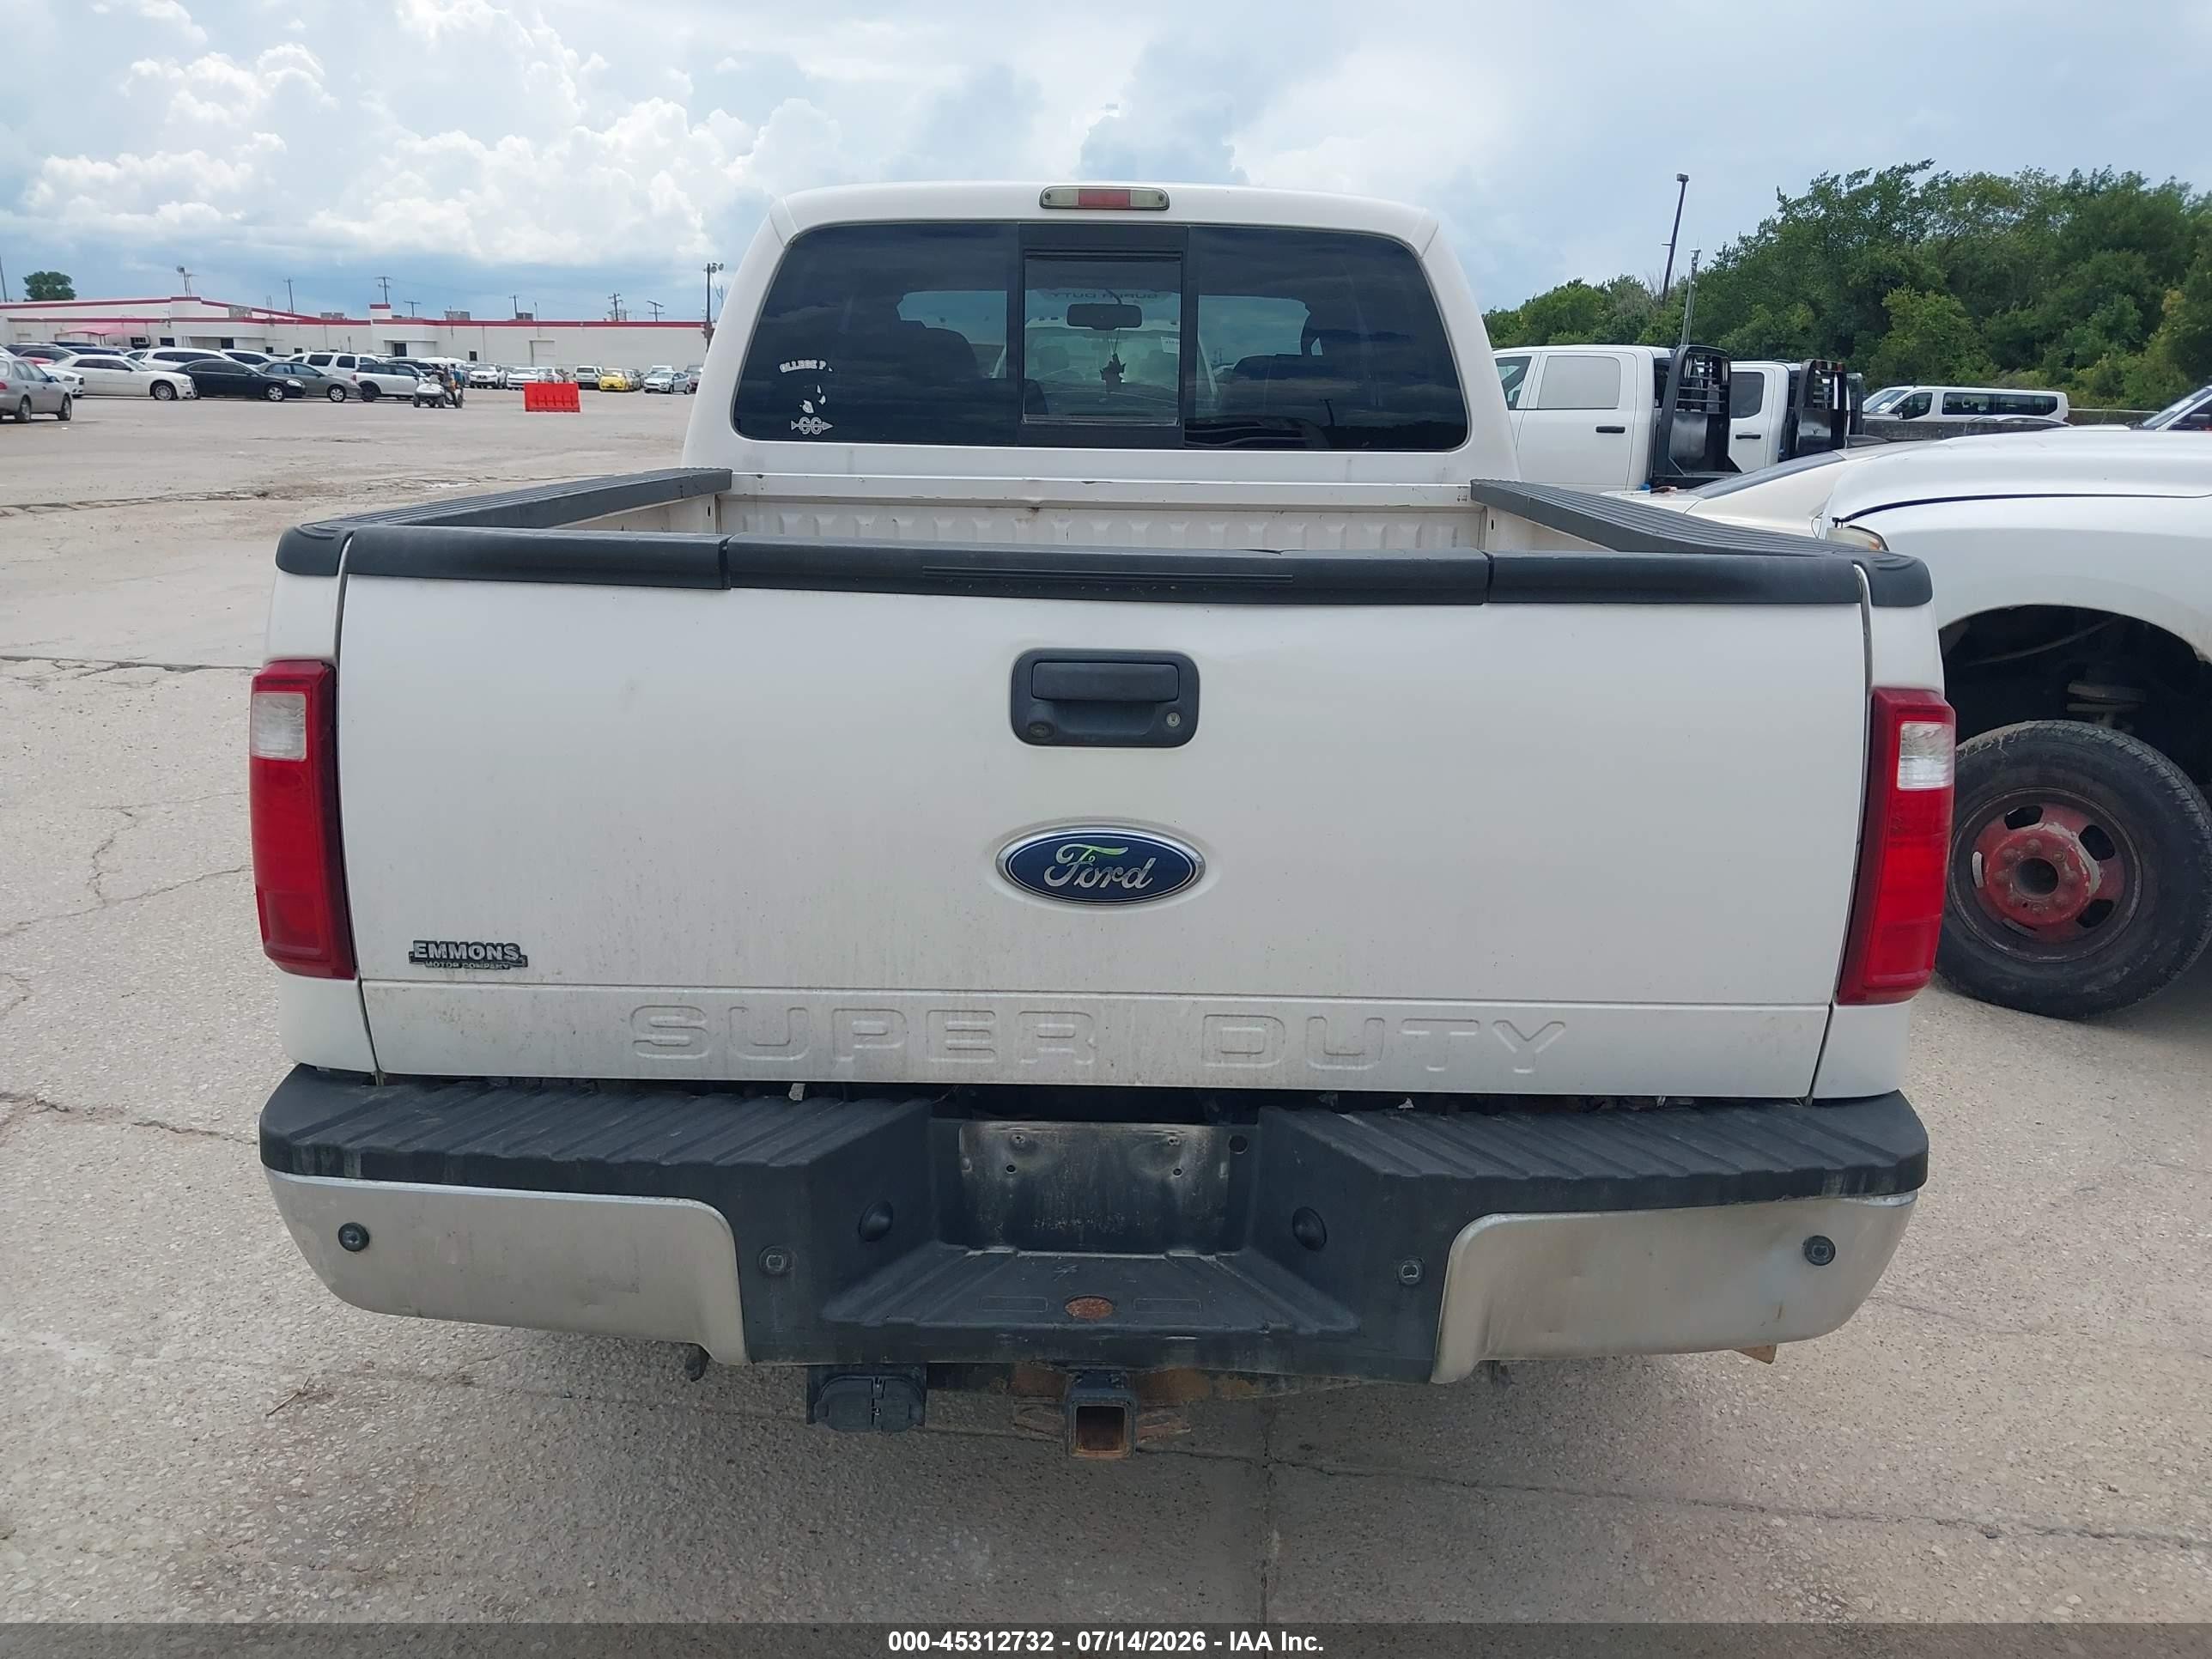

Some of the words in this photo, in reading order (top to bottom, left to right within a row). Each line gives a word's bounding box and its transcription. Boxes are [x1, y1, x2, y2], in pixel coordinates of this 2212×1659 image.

[1043, 843, 1157, 889] Ford
[413, 941, 520, 962] EMMONS
[426, 960, 459, 969] MOTOR
[629, 1005, 1095, 1064] SUPER
[1201, 1013, 1566, 1074] DUTY
